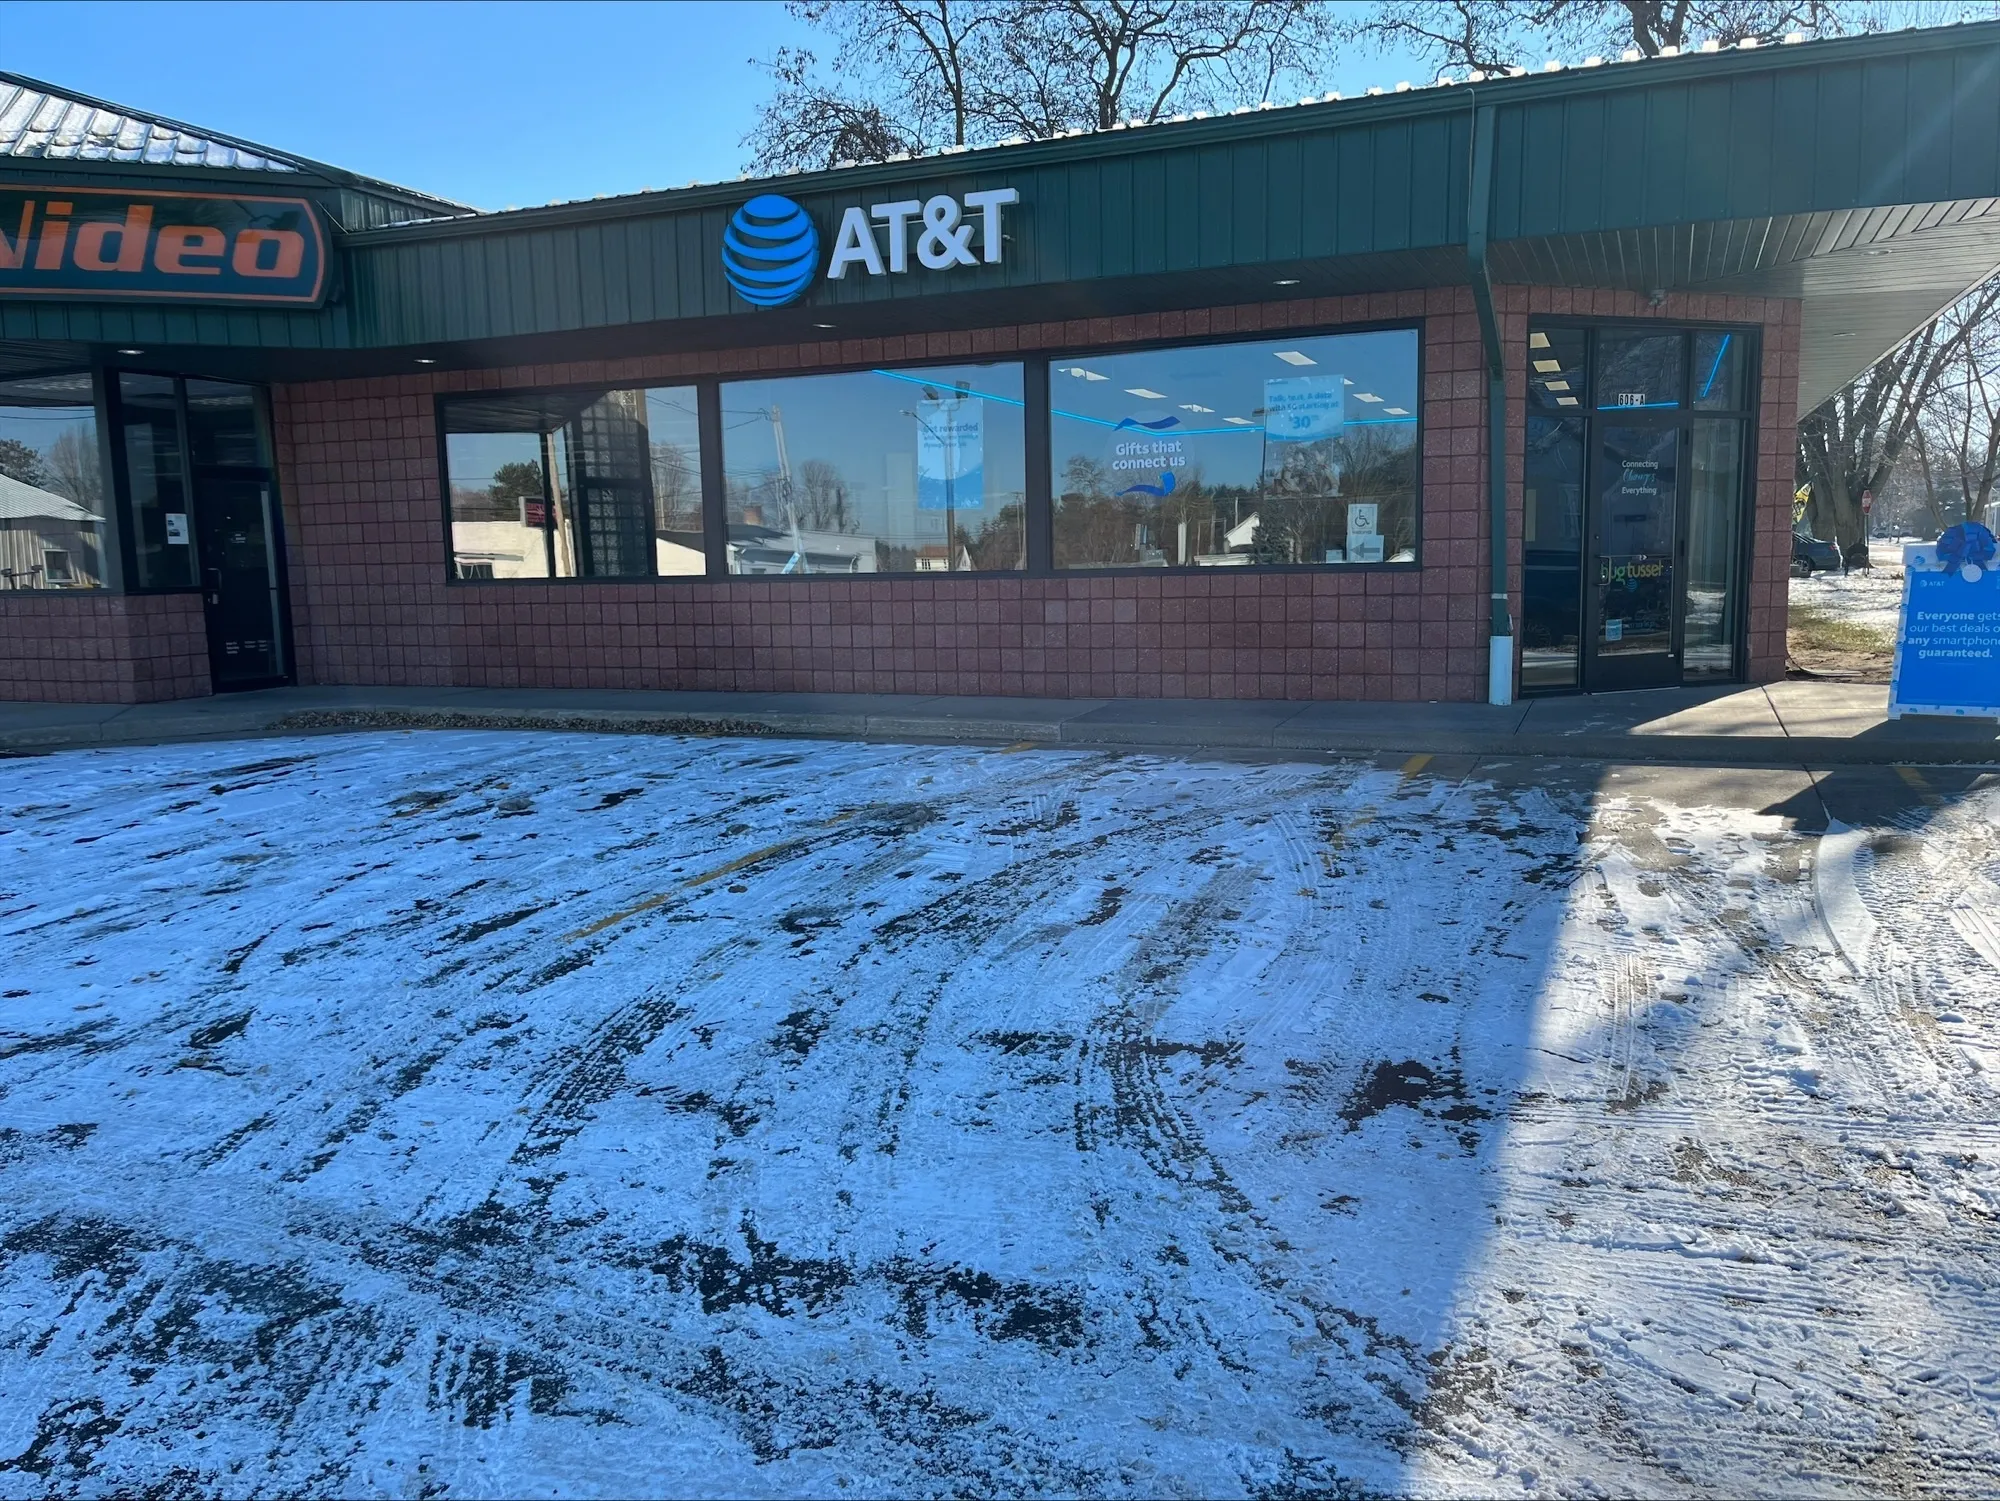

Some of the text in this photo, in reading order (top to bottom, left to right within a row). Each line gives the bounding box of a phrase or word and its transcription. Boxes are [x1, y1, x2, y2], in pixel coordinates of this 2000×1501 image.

[827, 188, 1019, 279] AT&T
[1620, 394, 1645, 405] 606-A
[940, 422, 978, 433] rewarded
[1116, 440, 1182, 456] Gifts that
[1112, 456, 1186, 470] connect us
[1622, 460, 1659, 470] Connecting
[1622, 486, 1657, 496] Everything
[1917, 611, 1974, 622] Everyone
[1909, 625, 1929, 633] our
[1931, 623, 1957, 633] best
[1959, 623, 1991, 633] deals
[1908, 636, 1930, 647] any
[1918, 648, 1993, 659] guaranteed.
